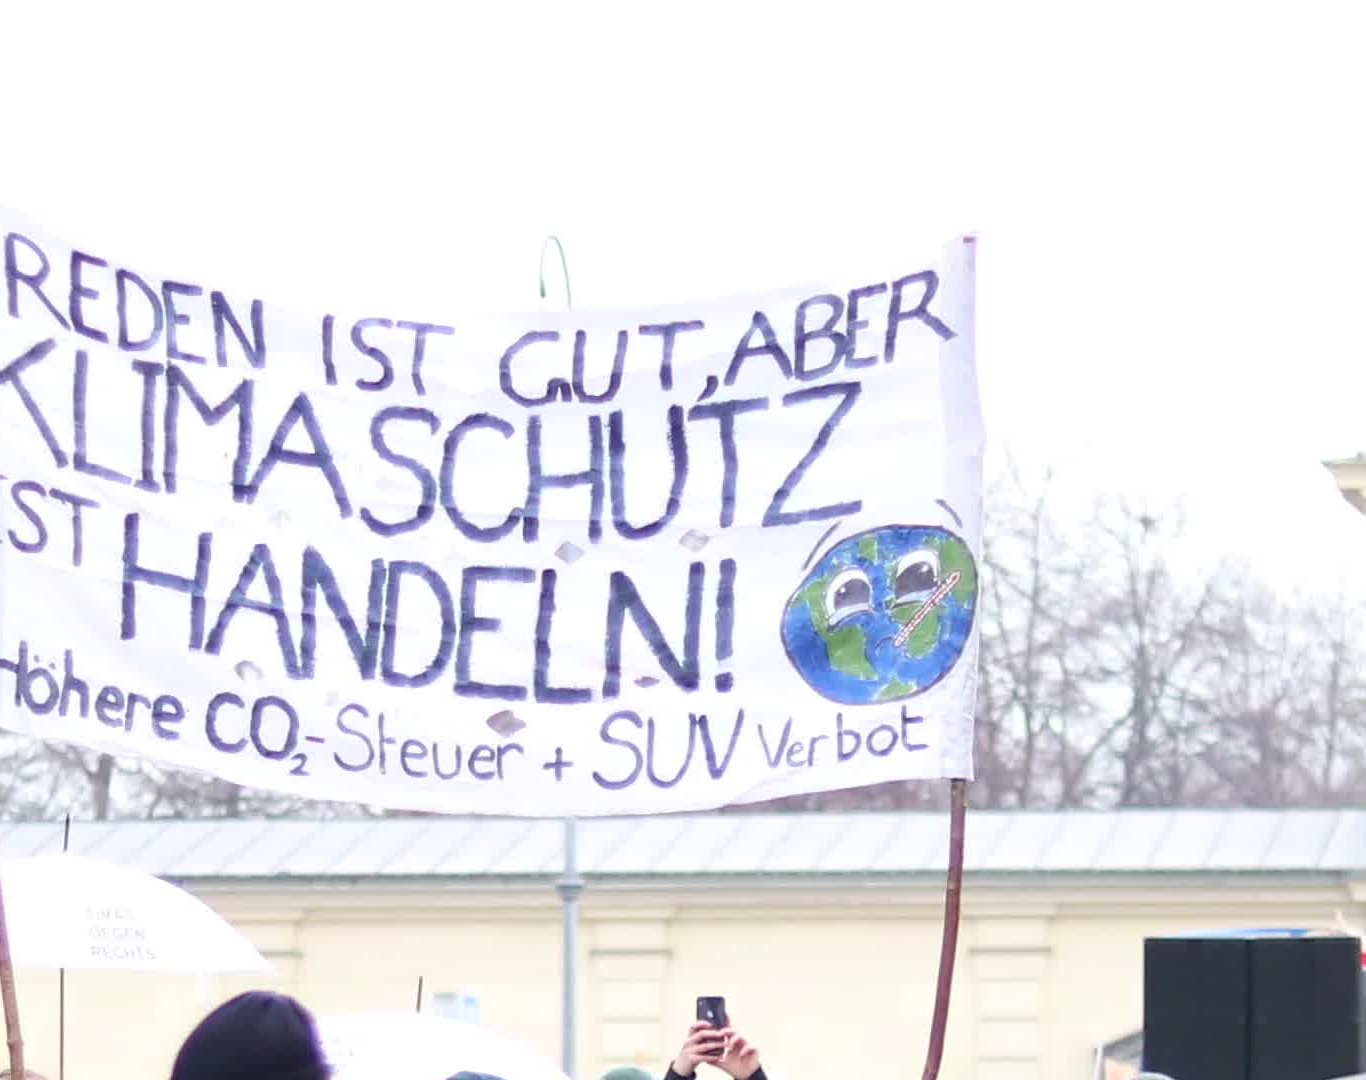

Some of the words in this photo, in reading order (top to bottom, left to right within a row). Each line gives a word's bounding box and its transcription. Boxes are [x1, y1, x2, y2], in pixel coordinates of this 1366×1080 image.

[4, 232, 266, 369] REDEN
[322, 314, 455, 396] IST
[121, 512, 734, 703] HANDELN!
[543, 746, 574, 782] +
[592, 708, 745, 790] SUV
[758, 704, 930, 769] Verbot
